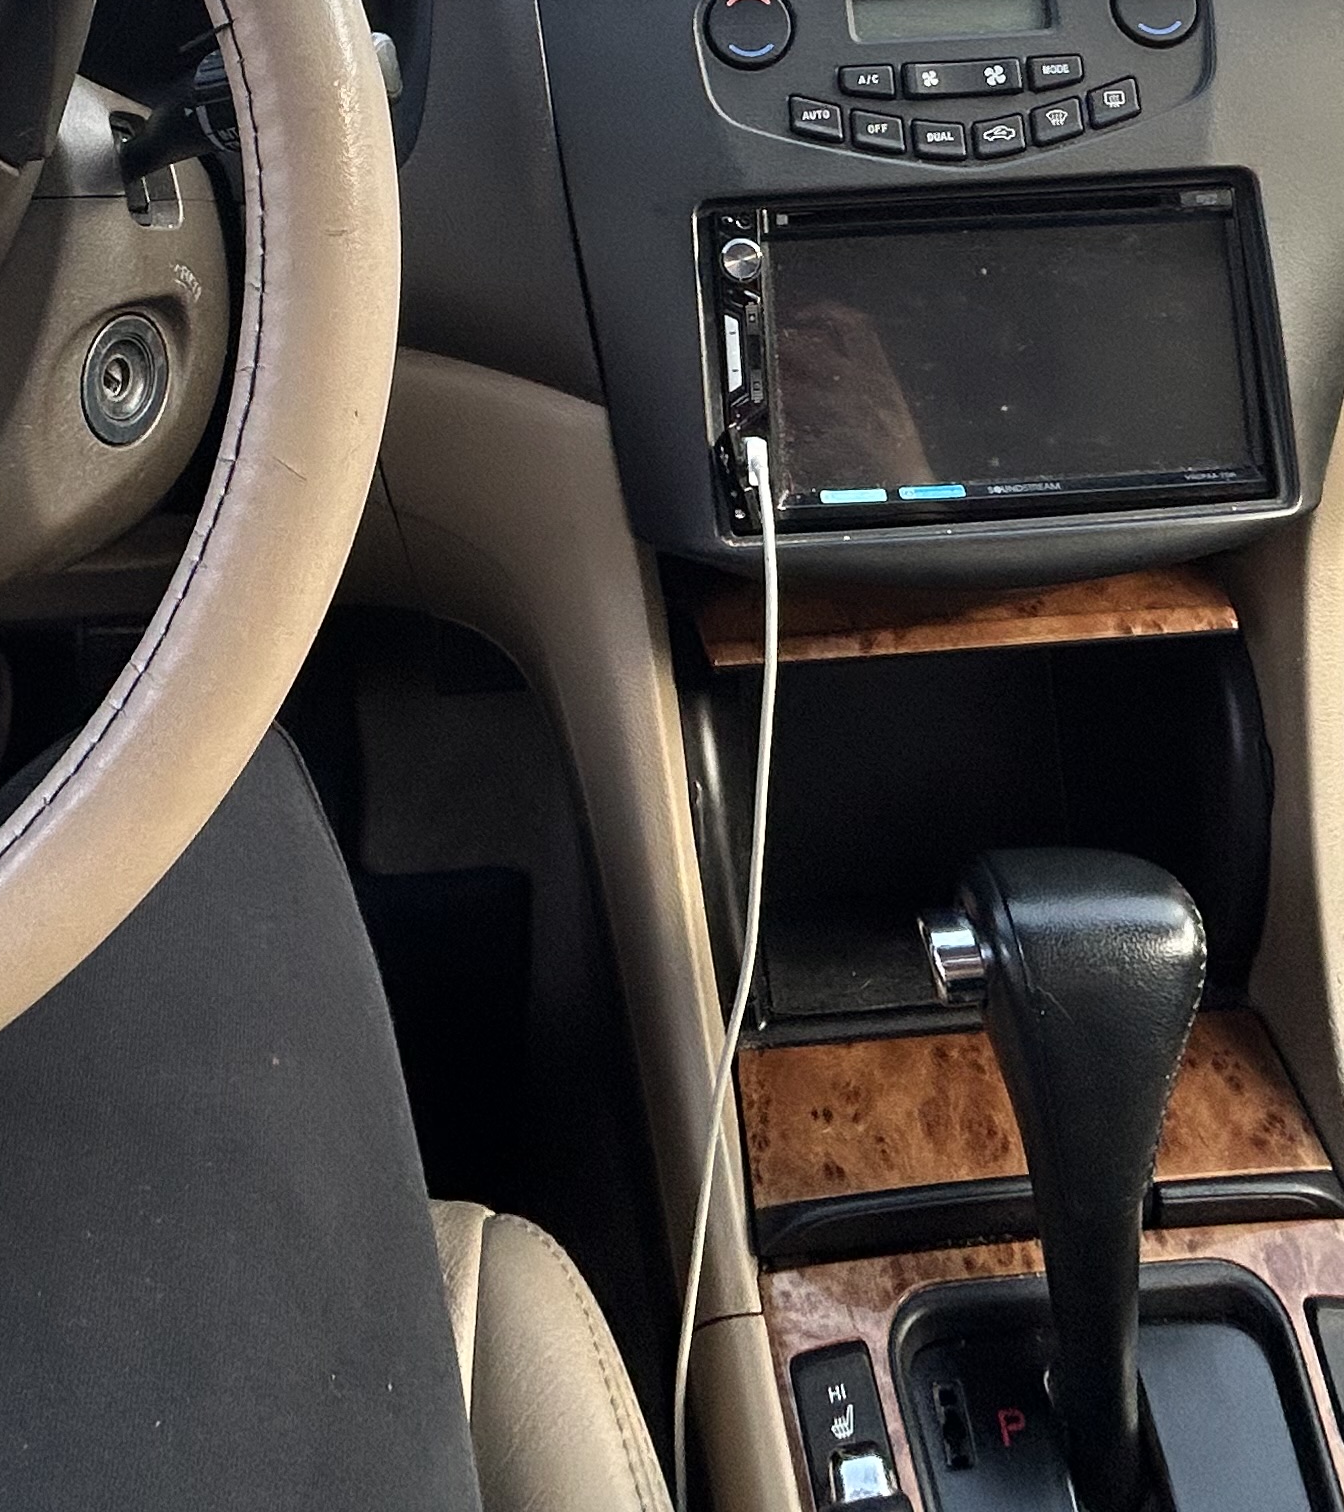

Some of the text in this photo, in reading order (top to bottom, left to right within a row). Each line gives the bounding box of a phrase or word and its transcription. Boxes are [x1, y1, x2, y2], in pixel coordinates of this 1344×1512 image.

[1042, 63, 1071, 76] MODE
[857, 73, 880, 86] A/C
[802, 108, 831, 122] AUTO
[867, 122, 889, 136] OFF
[926, 130, 955, 143] DUAL
[986, 482, 1062, 495] SOUNDSTREAM
[828, 1383, 847, 1404] HI
[997, 1407, 1026, 1448] P
